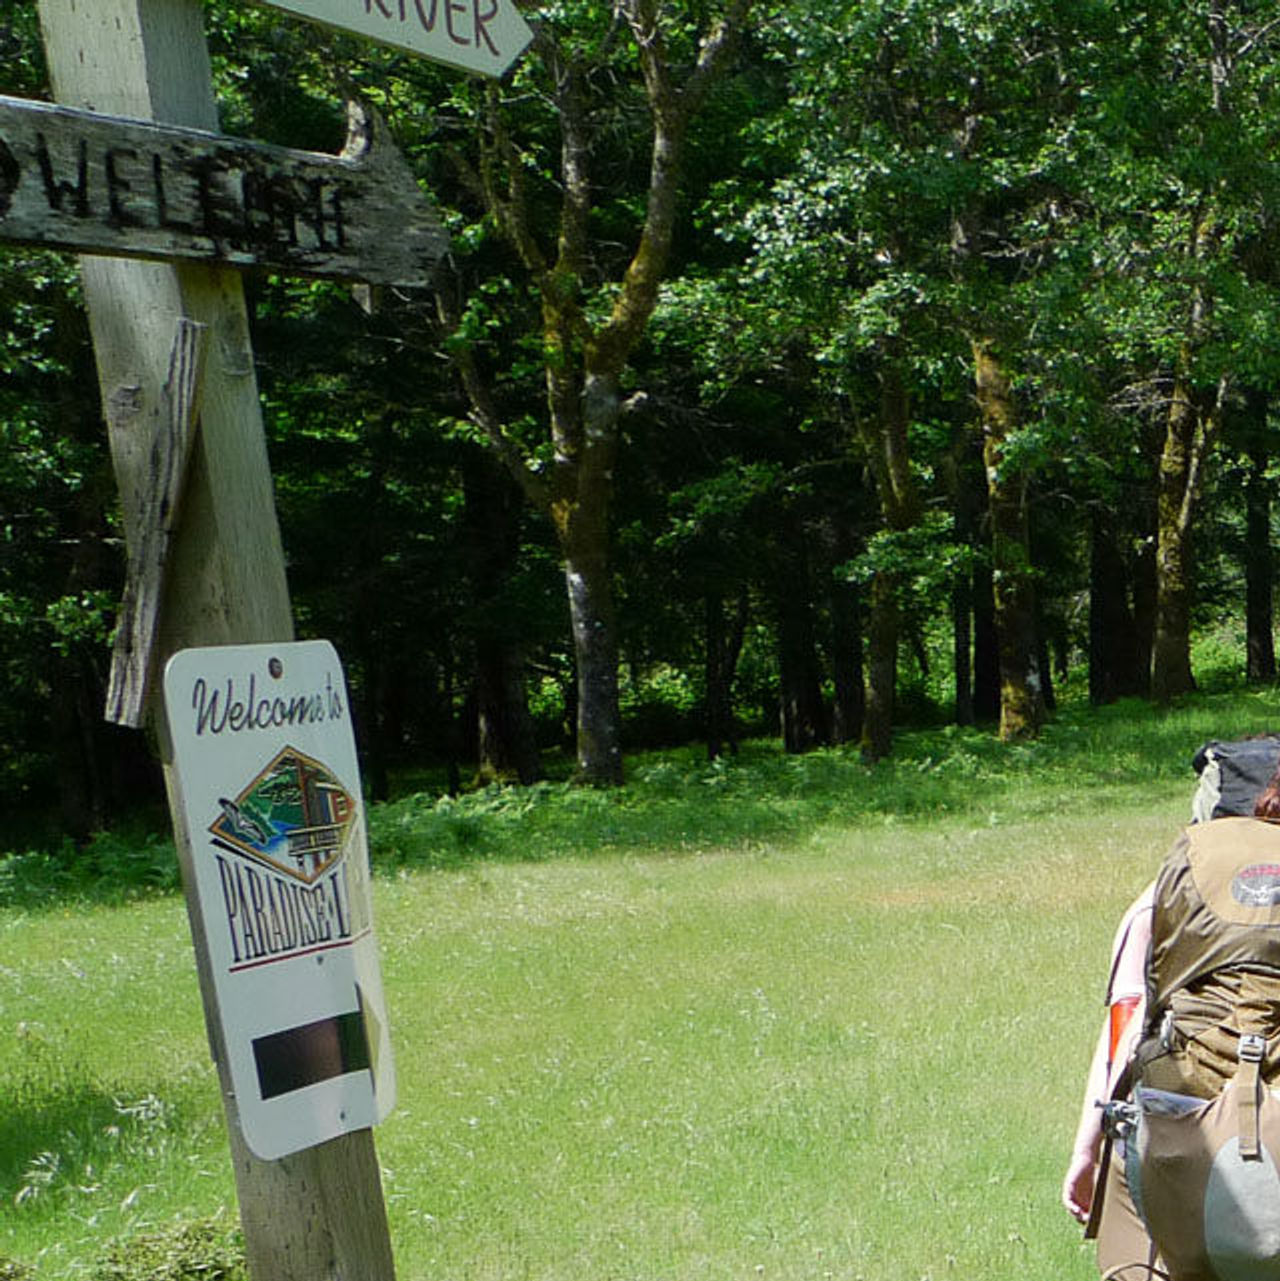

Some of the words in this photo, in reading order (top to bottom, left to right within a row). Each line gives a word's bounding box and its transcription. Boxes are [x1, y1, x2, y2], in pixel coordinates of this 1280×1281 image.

[345, 0, 501, 57] VER
[192, 673, 324, 736] Welcome
[325, 671, 343, 720] to
[216, 854, 331, 962] PARADISE
